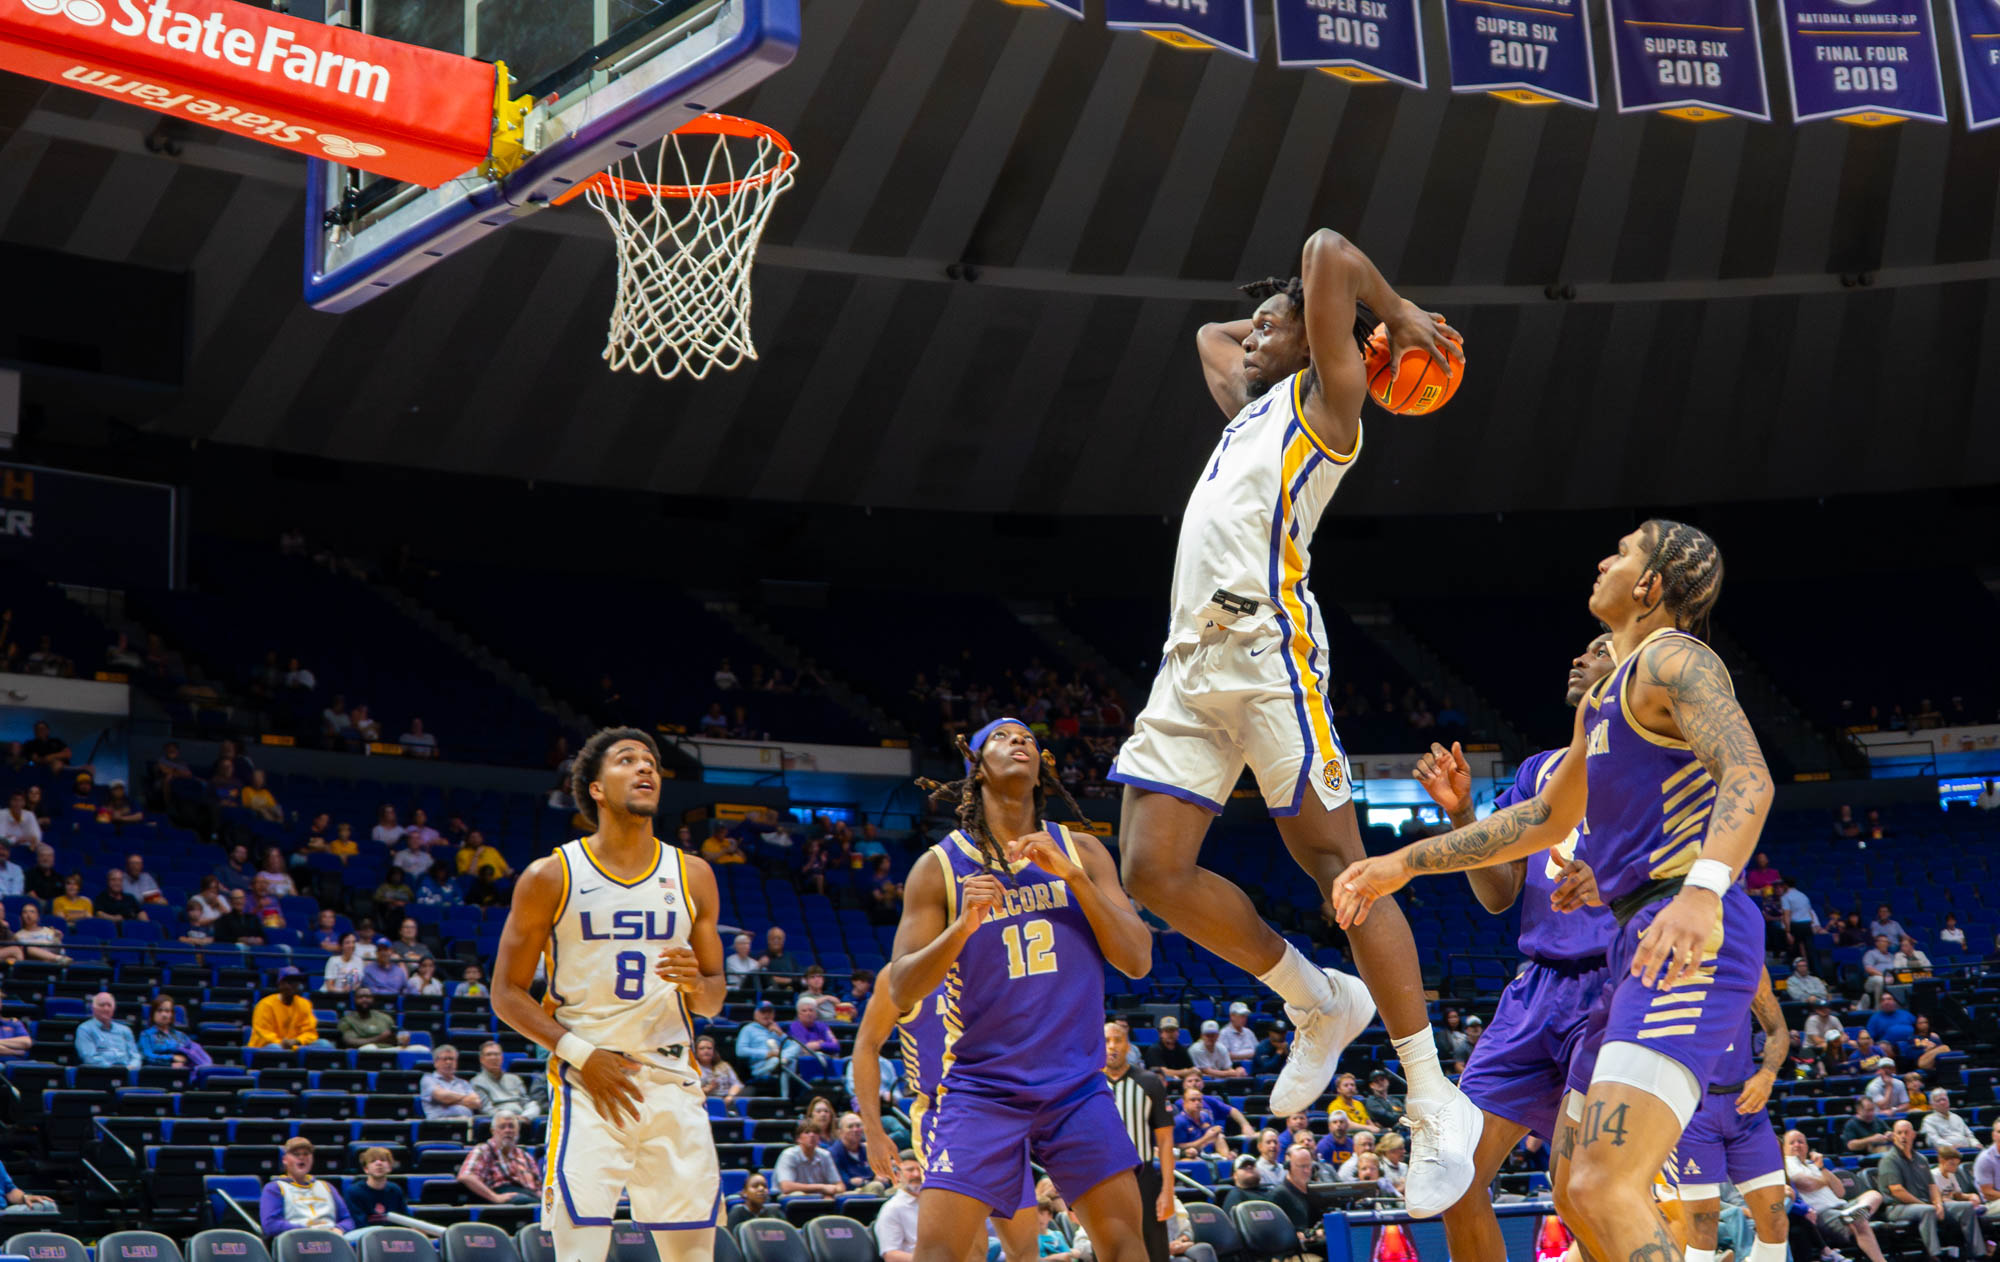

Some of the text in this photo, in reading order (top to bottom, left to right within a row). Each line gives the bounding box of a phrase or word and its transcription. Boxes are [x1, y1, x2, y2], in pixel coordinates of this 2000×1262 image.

[1361, 0, 1388, 19] SIX
[1798, 12, 1918, 25] NATIONAL RUNNER-UP
[1317, 13, 1380, 49] 2016
[1475, 15, 1558, 42] SUPER SIX
[1489, 38, 1549, 72] 2017
[1644, 36, 1728, 58] SUPER SIX
[1816, 45, 1909, 62] FINAL FOUR
[1658, 58, 1721, 87] 2018
[1833, 66, 1899, 91] 2019
[982, 880, 1069, 924] CORN
[580, 910, 677, 941] LSU
[1002, 918, 1059, 979] 12
[614, 950, 646, 1001] 8
[28, 1246, 67, 1259] LSU
[121, 1244, 158, 1258] LSU
[211, 1242, 248, 1255] LSU
